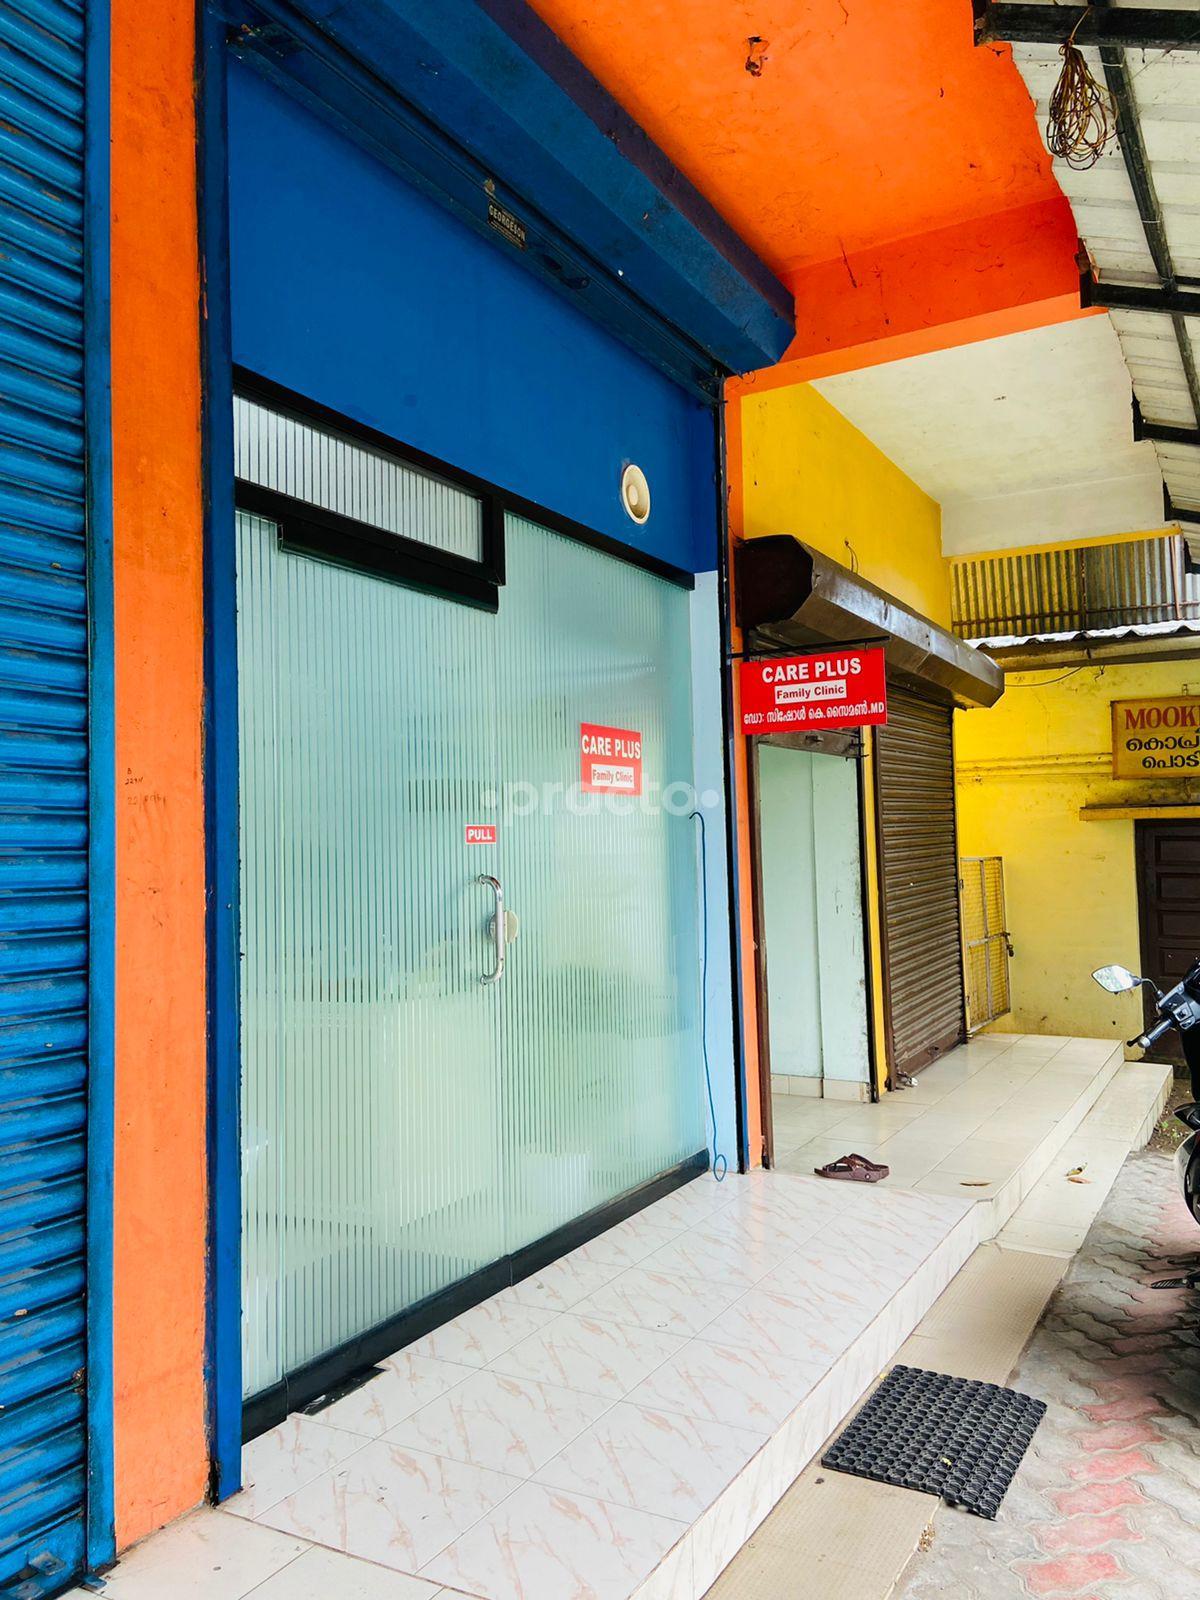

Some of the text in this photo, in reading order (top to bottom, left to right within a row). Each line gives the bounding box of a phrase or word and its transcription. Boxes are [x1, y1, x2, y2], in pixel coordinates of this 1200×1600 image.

[762, 658, 862, 683] CARE PLUS
[776, 684, 845, 700] Family Clinic
[1124, 705, 1200, 729] MOOK
[581, 734, 641, 760] CARE PLUS
[592, 768, 633, 784] Family Clinic
[468, 828, 493, 841] PULL
